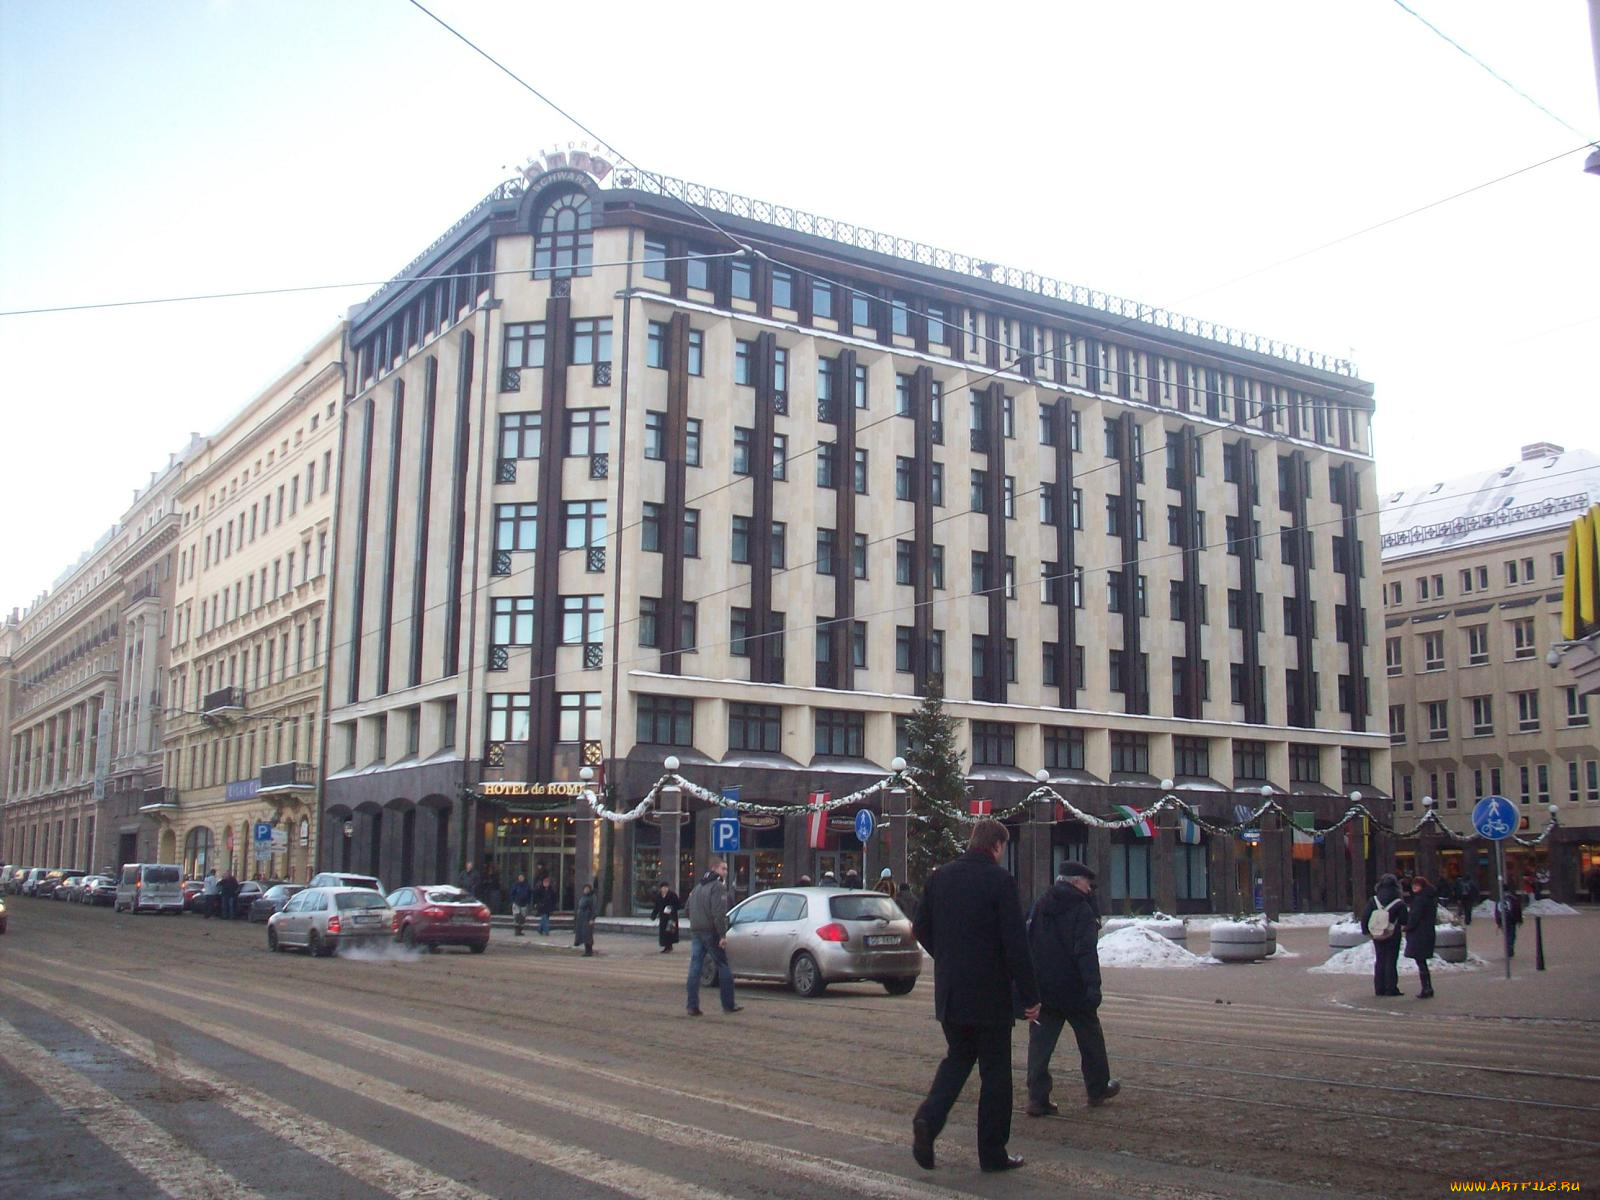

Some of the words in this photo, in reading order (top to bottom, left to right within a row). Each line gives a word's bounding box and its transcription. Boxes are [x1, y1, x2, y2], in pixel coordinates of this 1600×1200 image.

[532, 171, 592, 192] SCHWARZ
[484, 783, 529, 795] HOTEL
[531, 782, 545, 795] de
[258, 825, 268, 839] P
[719, 823, 734, 849] P
